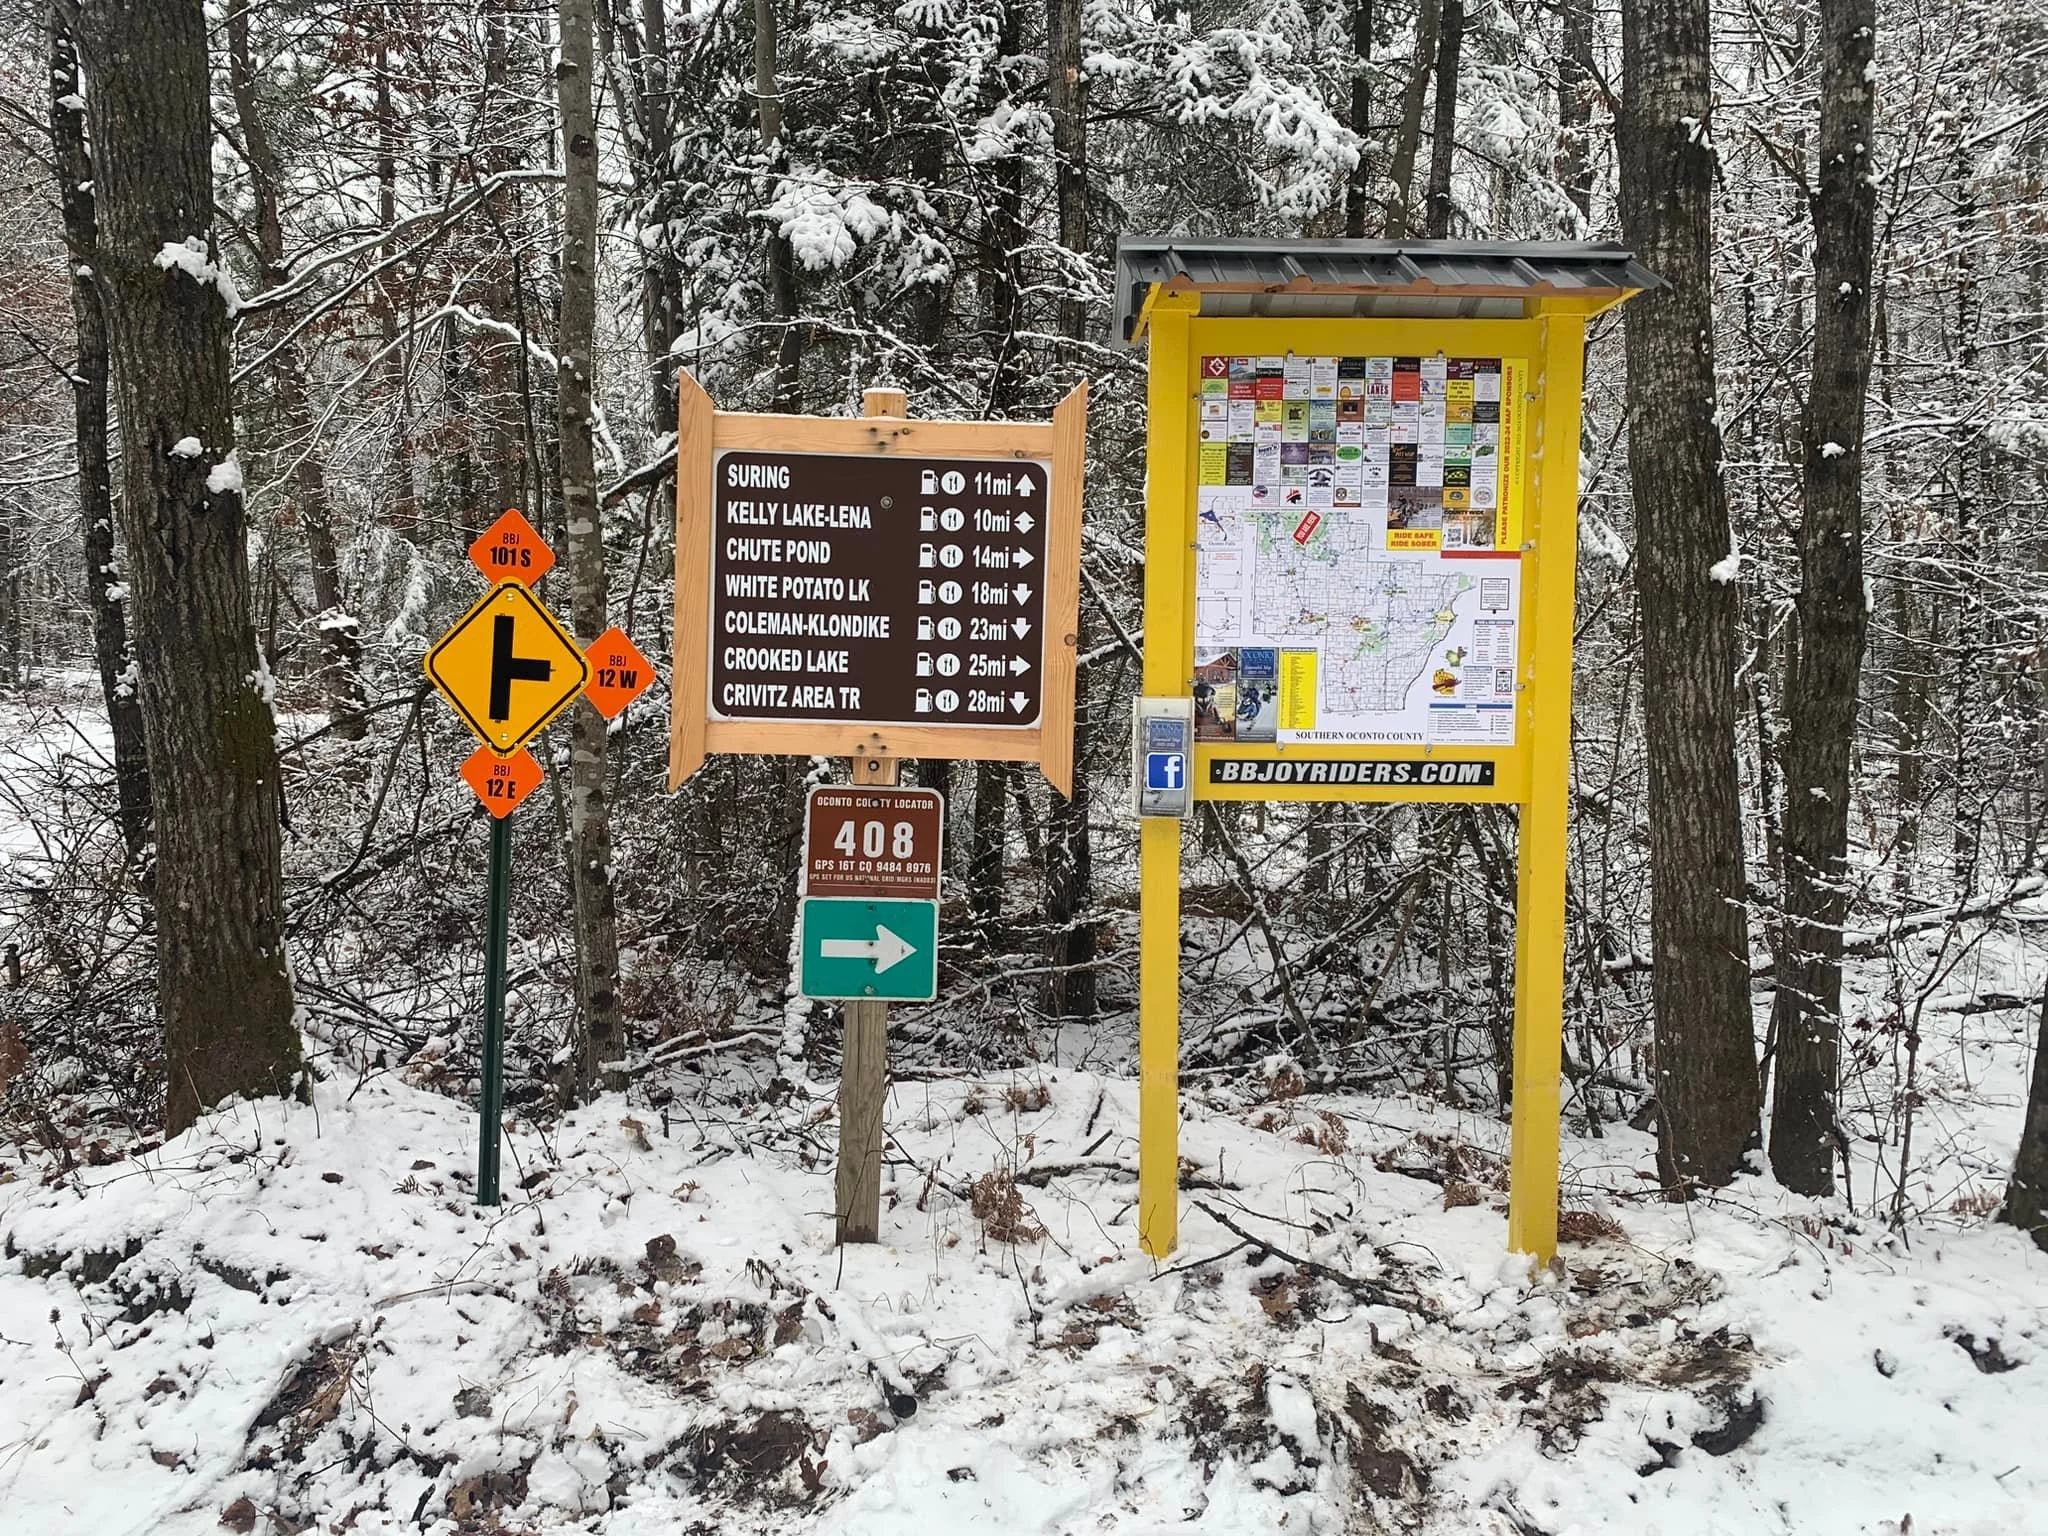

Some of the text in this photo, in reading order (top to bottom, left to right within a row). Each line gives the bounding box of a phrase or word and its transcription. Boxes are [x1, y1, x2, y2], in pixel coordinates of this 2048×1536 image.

[728, 464, 1011, 496] SURING 11mi
[728, 501, 1010, 532] KELLY LAKE-LENA 10mi
[502, 533, 520, 544] BBJ
[490, 547, 531, 567] 101 S
[726, 538, 1009, 568] CHUTE POND 14mi
[726, 574, 1008, 605] WHITE POTATO LK 18mi
[725, 611, 1007, 640] COLEMAN-KLONDIKE 23mi
[609, 655, 627, 666] BBJ
[724, 647, 1006, 677] CROOKED LAKE 25mi
[598, 669, 637, 689] 12 W
[723, 684, 1005, 712] CRIVITZ AREA TR 28mi
[1296, 731, 1424, 740] SOUTHERN OCONTO COUNTY
[493, 765, 510, 776] BBJ
[1221, 762, 1482, 784] BBJOYRIDERS.COM
[486, 779, 516, 799] 12 E
[817, 797, 934, 809] OCONTO COUTY LOCATOR
[834, 820, 913, 859] 408
[815, 860, 834, 870] GPS
[838, 861, 856, 871] 16T
[859, 861, 872, 873] CQ
[876, 862, 902, 872] 9484
